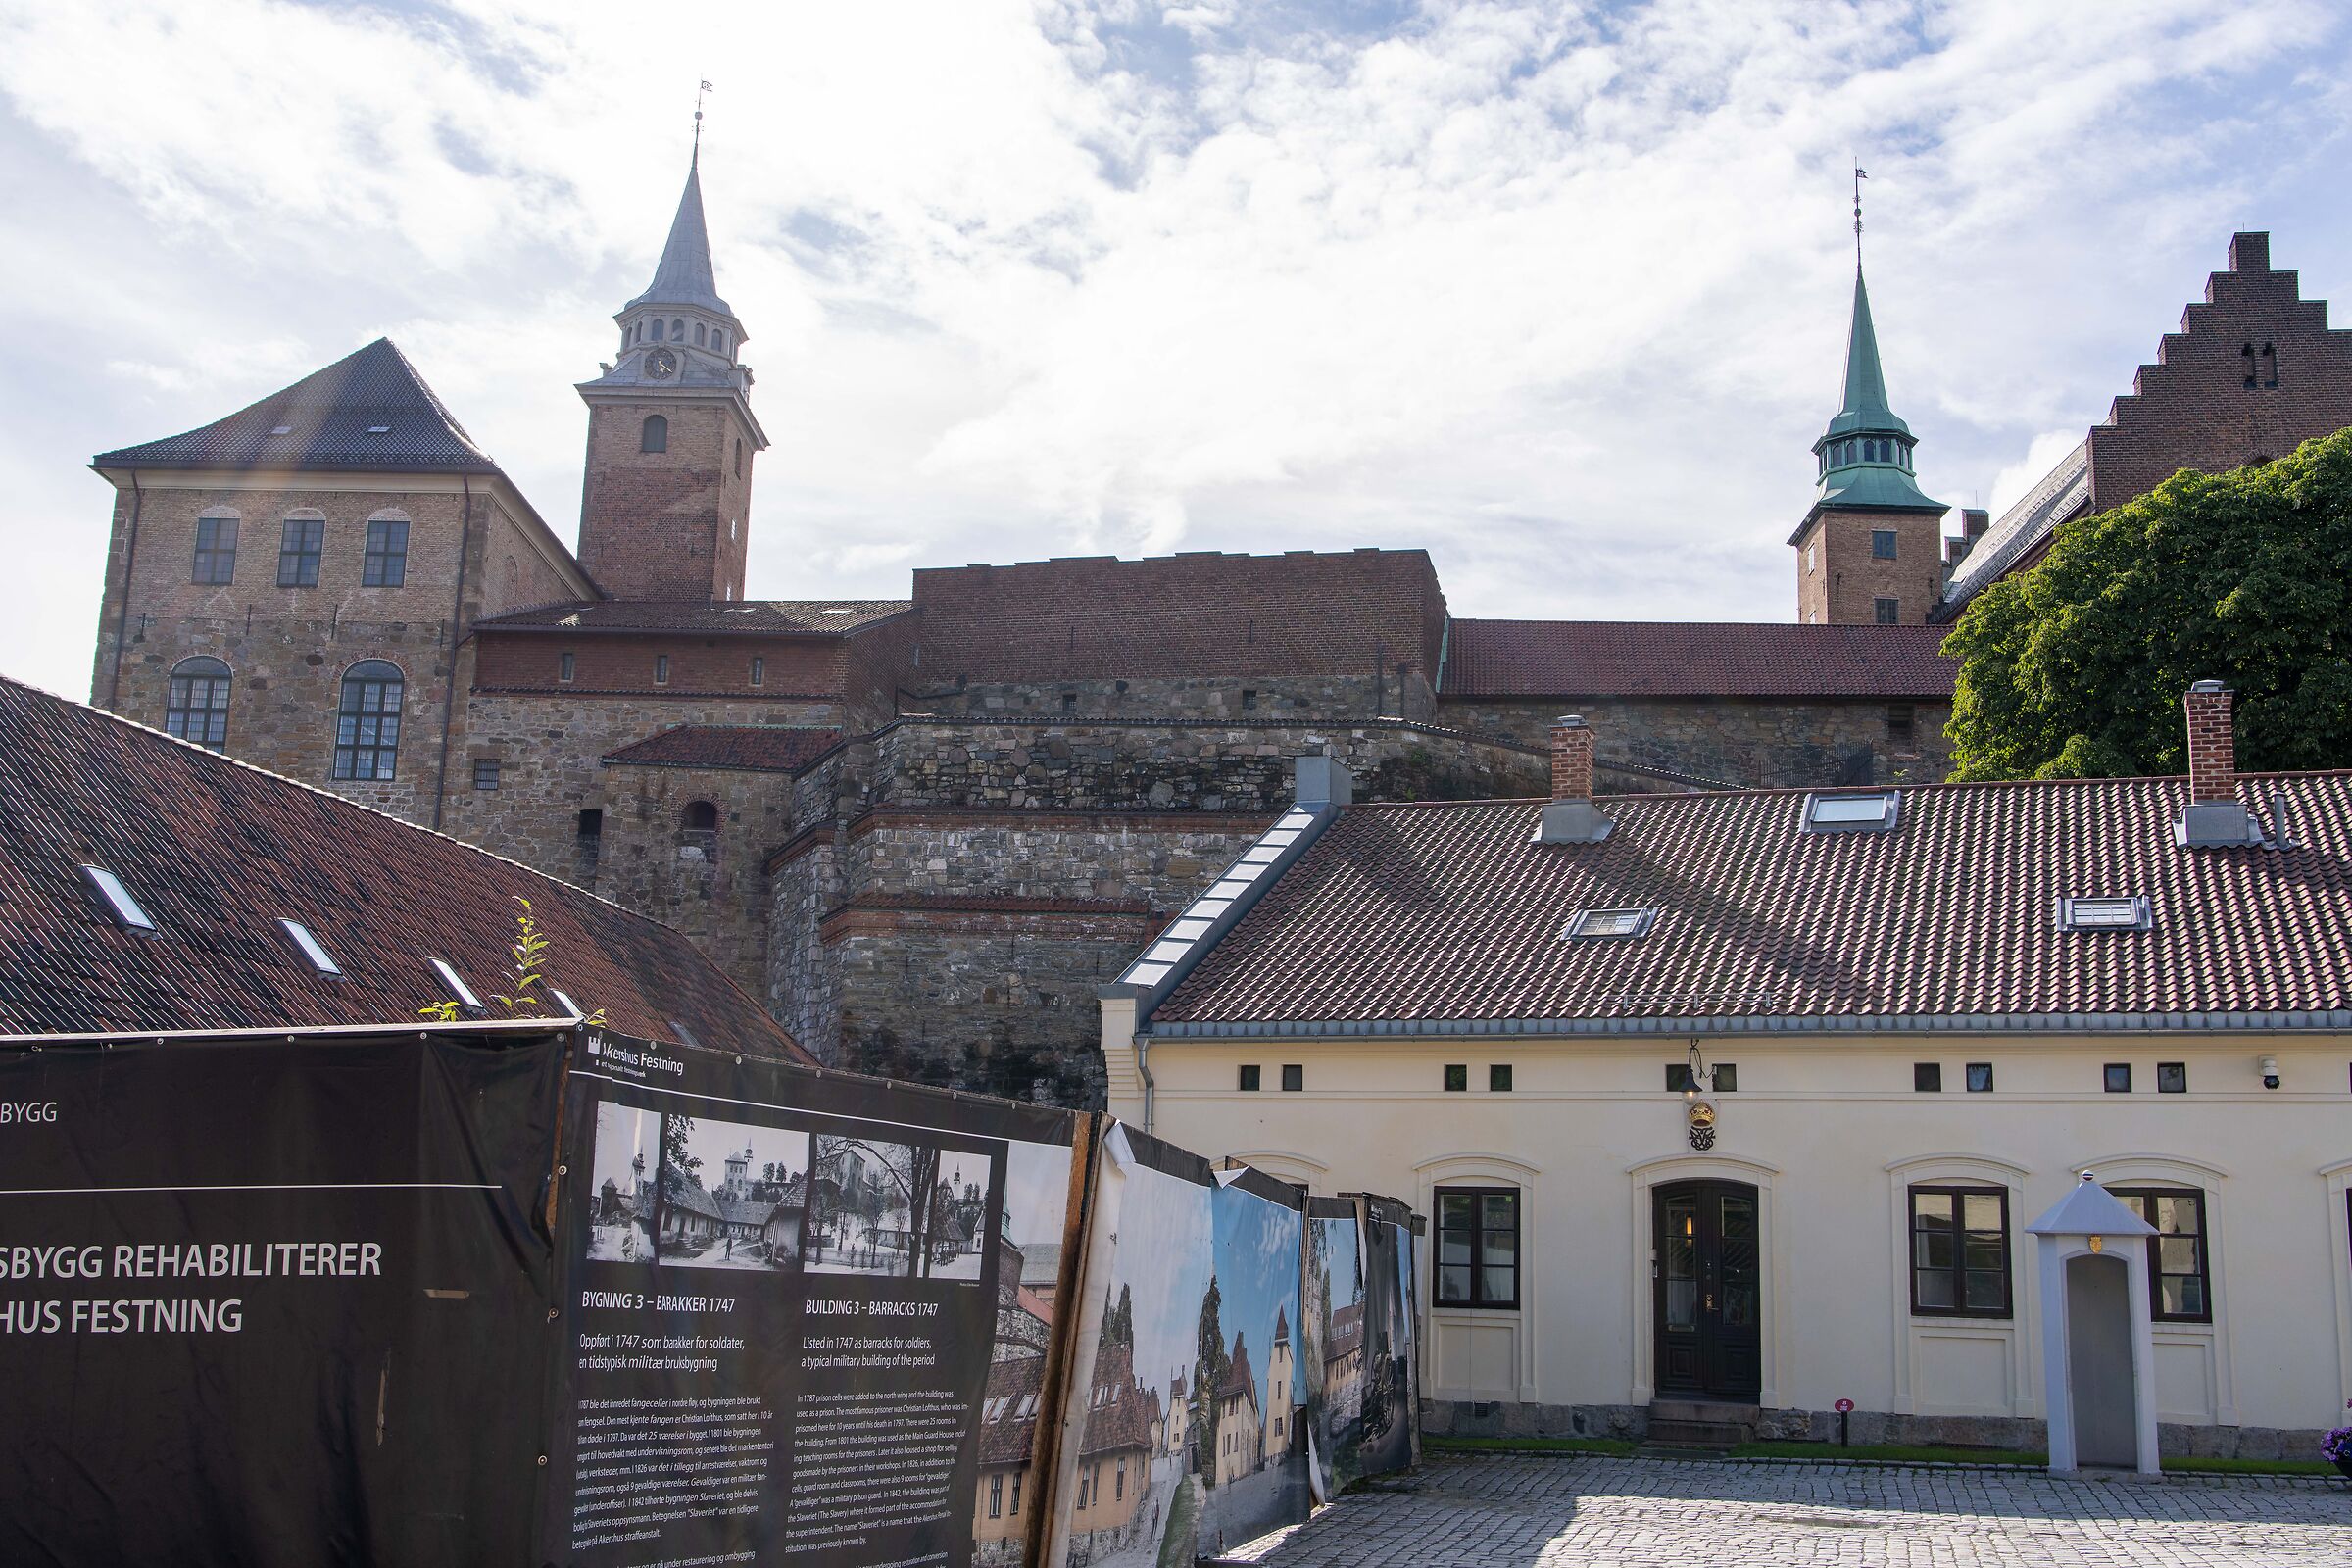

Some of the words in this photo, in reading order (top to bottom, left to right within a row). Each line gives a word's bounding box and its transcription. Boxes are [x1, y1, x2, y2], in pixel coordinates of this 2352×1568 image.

[641, 1052, 684, 1077] Festning
[0, 1102, 58, 1124] BYGG
[113, 1243, 382, 1277] REHABILITERER
[582, 1291, 633, 1309] BYGNING
[635, 1294, 643, 1309] 3
[656, 1295, 706, 1312] BARAKKER
[710, 1298, 735, 1312] 1747
[806, 1299, 853, 1314] BUILDING
[853, 1301, 859, 1315] 3
[868, 1301, 915, 1316] BARRACKS
[917, 1303, 939, 1316] 1747
[72, 1298, 243, 1334] FESTNING
[579, 1333, 610, 1350] Oppført
[615, 1334, 639, 1348] 1747
[641, 1338, 662, 1348] som
[663, 1335, 694, 1348] barakker
[696, 1335, 708, 1348] for
[709, 1336, 745, 1350] soldater,
[803, 1336, 825, 1348] Listed
[826, 1337, 833, 1348] in
[835, 1337, 853, 1348] 1747
[854, 1339, 862, 1348] as
[862, 1336, 892, 1348] barracks
[894, 1336, 904, 1348] for
[904, 1337, 931, 1349] soldiers,
[578, 1358, 586, 1369] en
[588, 1354, 627, 1372] tidstypisk
[628, 1355, 664, 1369] militær
[664, 1355, 717, 1373] bruksbygning
[808, 1354, 833, 1370] typical
[833, 1354, 860, 1369] military
[862, 1354, 892, 1369] building
[892, 1353, 901, 1366] of
[900, 1353, 911, 1366] the
[912, 1354, 935, 1368] period
